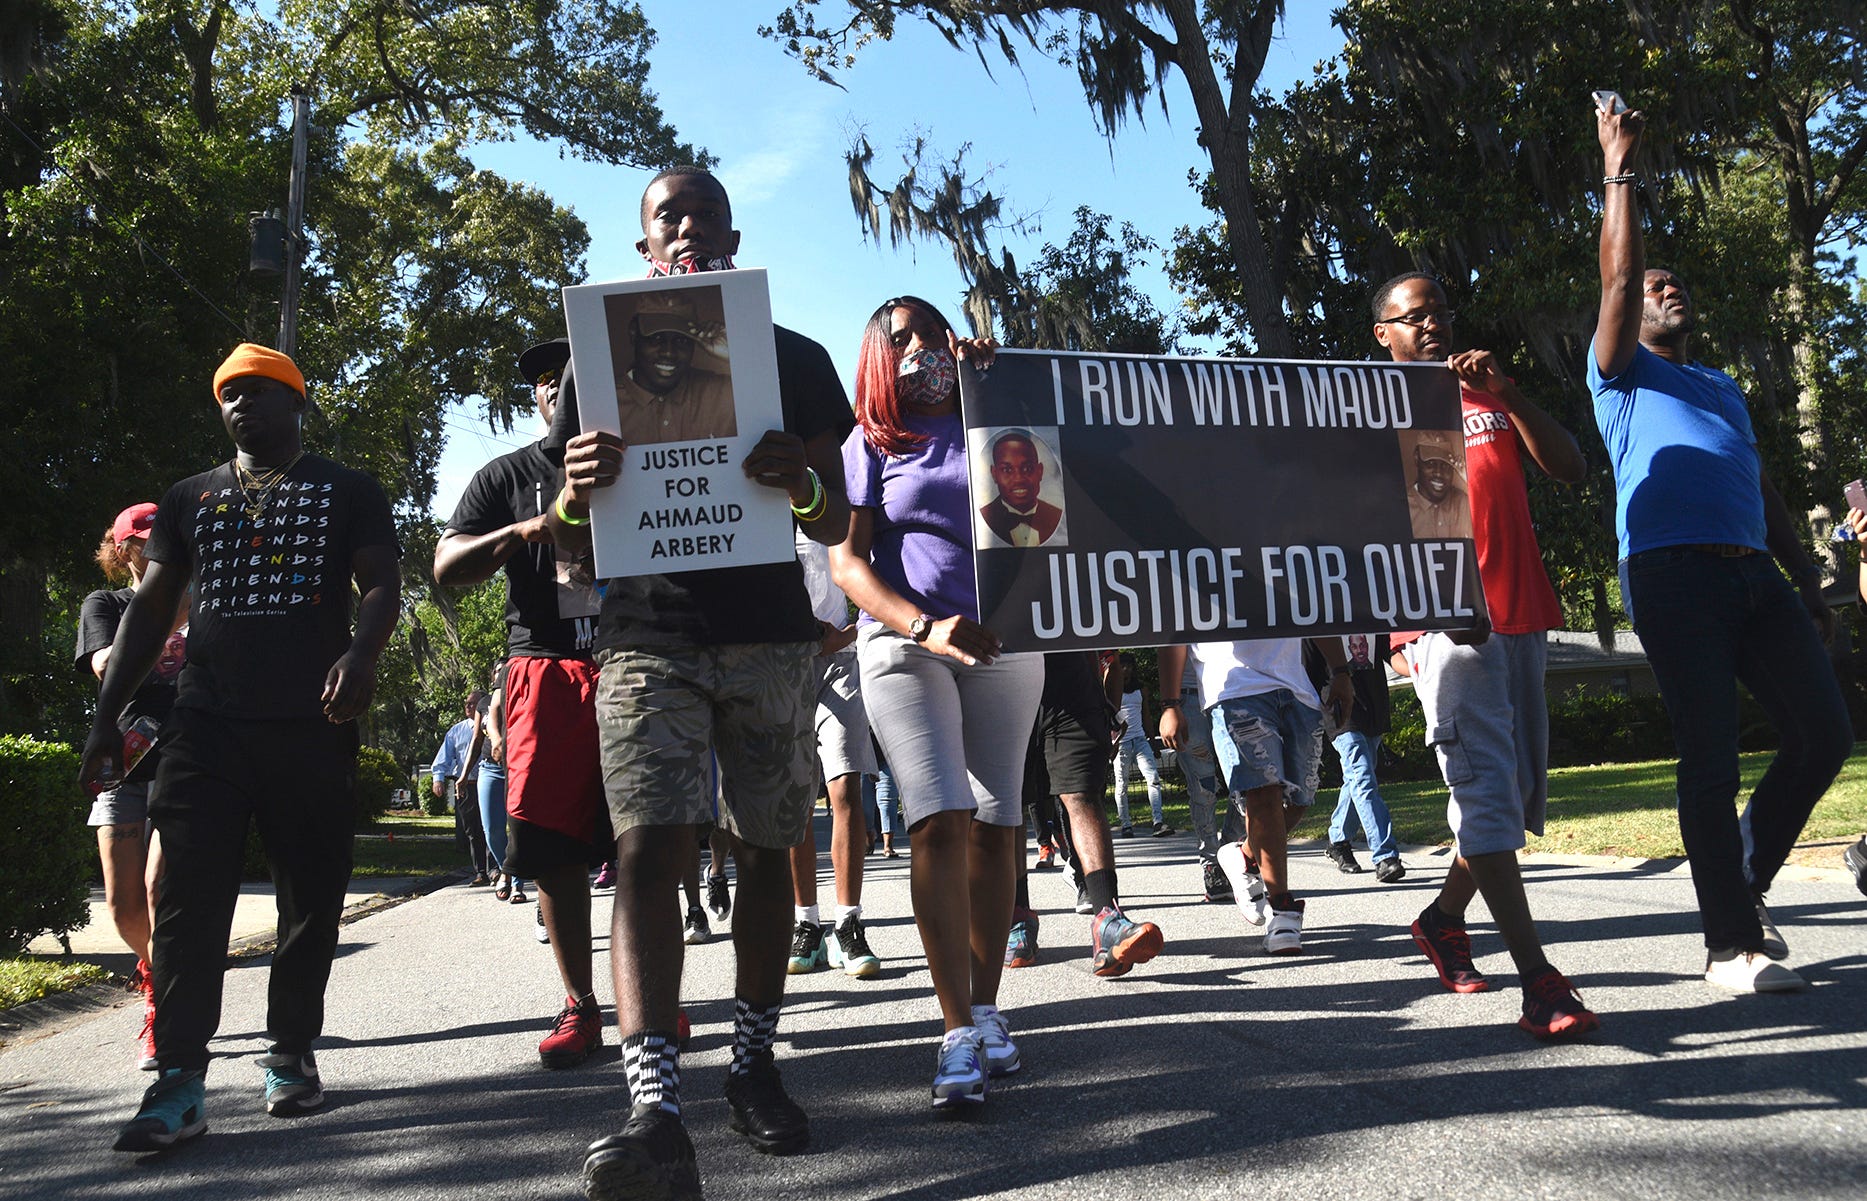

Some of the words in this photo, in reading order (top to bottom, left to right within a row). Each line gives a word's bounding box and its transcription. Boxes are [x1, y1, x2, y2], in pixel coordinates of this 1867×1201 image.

[1051, 359, 1065, 425] I
[1079, 360, 1174, 426] RUN
[1180, 362, 1291, 427] WITH
[1297, 366, 1413, 430] MAUD
[641, 445, 729, 471] JUSTICE
[665, 477, 711, 498] FOR
[638, 504, 743, 530] AHMAUD
[650, 533, 735, 559] ARBERY
[1031, 547, 1248, 639] JUSTICE
[1261, 545, 1353, 627] FOR
[1363, 542, 1474, 627] QUEZ
